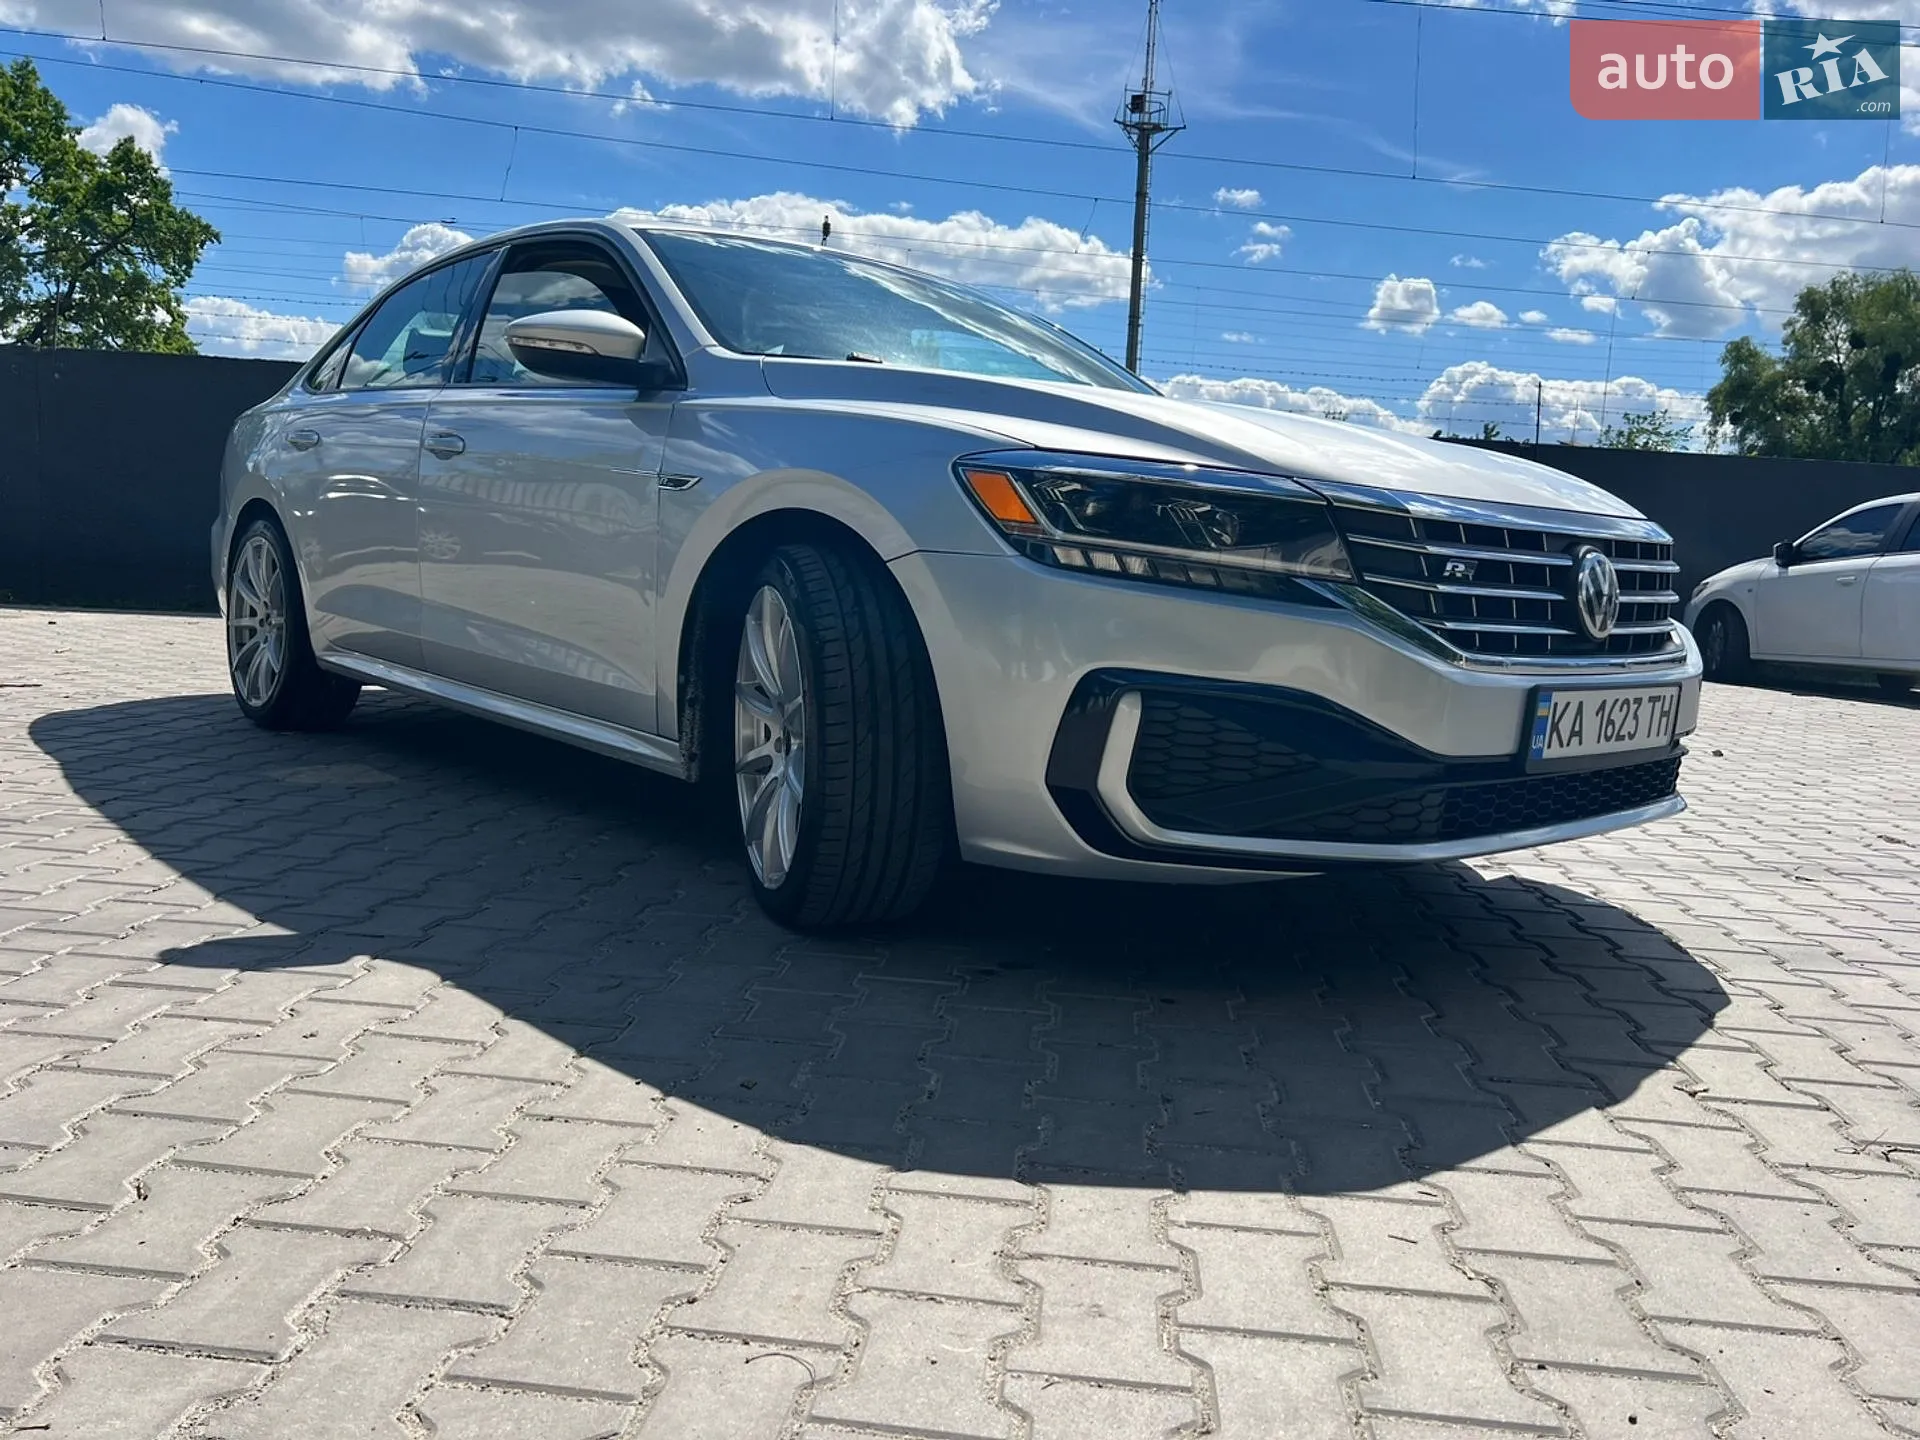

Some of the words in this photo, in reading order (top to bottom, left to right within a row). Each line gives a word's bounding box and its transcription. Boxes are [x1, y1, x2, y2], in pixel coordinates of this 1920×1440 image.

[1546, 700, 1584, 750] KA
[1595, 697, 1642, 745] 1623
[1646, 694, 1674, 739] TH
[1531, 734, 1544, 750] UA
